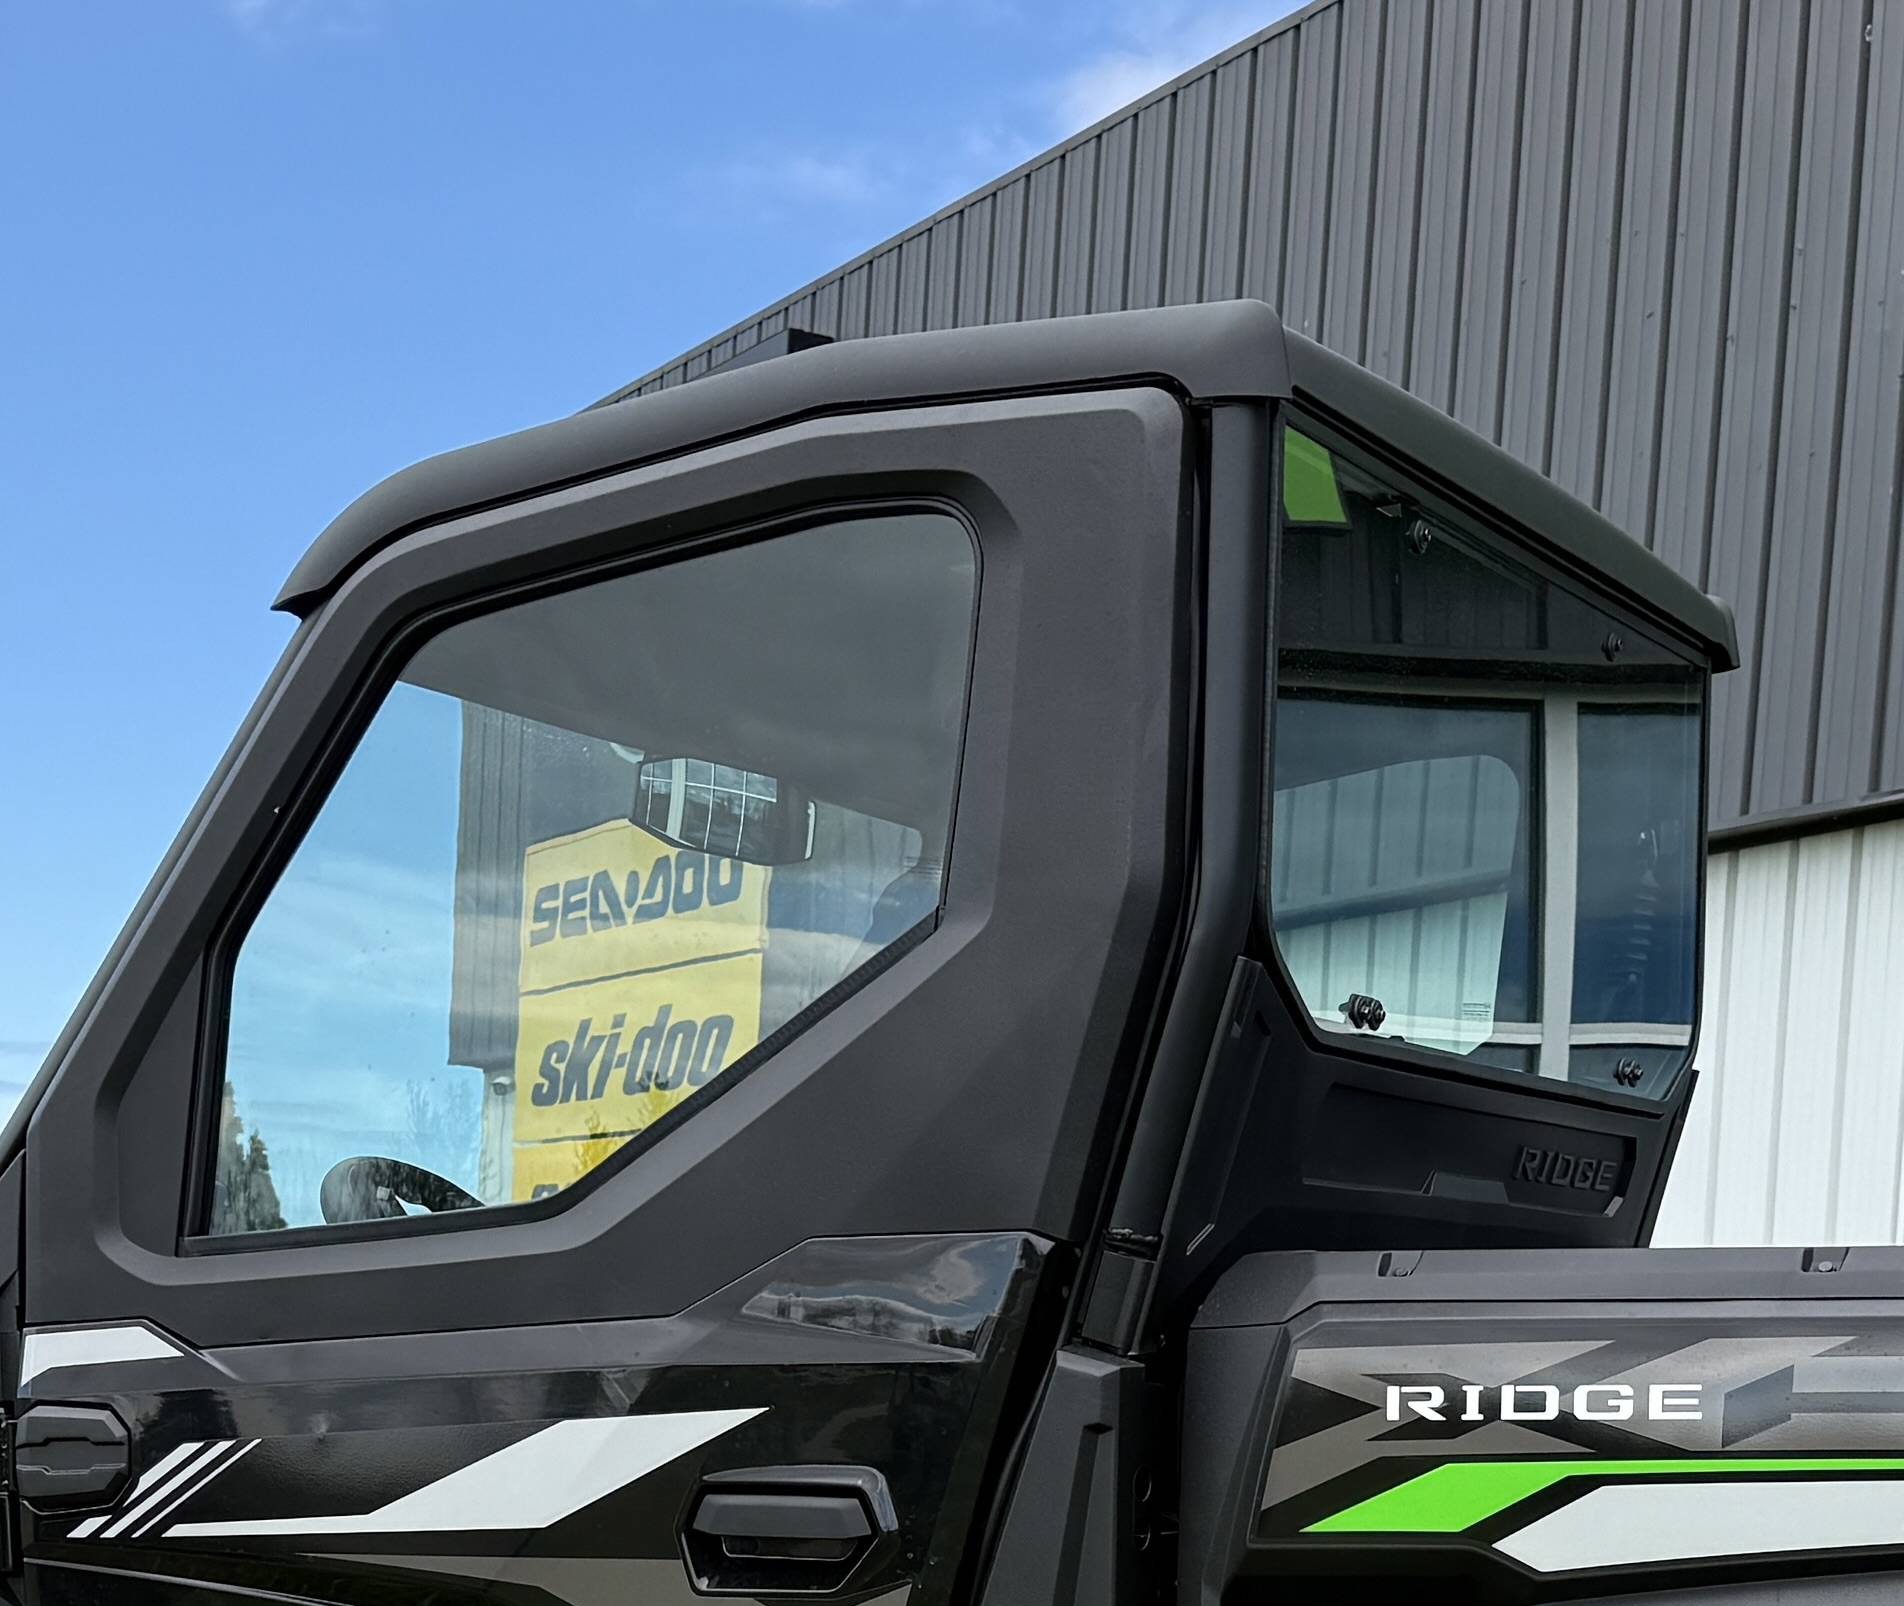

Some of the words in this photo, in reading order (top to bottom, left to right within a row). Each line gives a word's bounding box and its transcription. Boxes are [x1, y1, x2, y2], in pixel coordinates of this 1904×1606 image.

[531, 1003, 734, 1108] ski-doo
[1513, 1146, 1617, 1191] RIDGE
[1386, 1384, 1703, 1421] RIDGE
